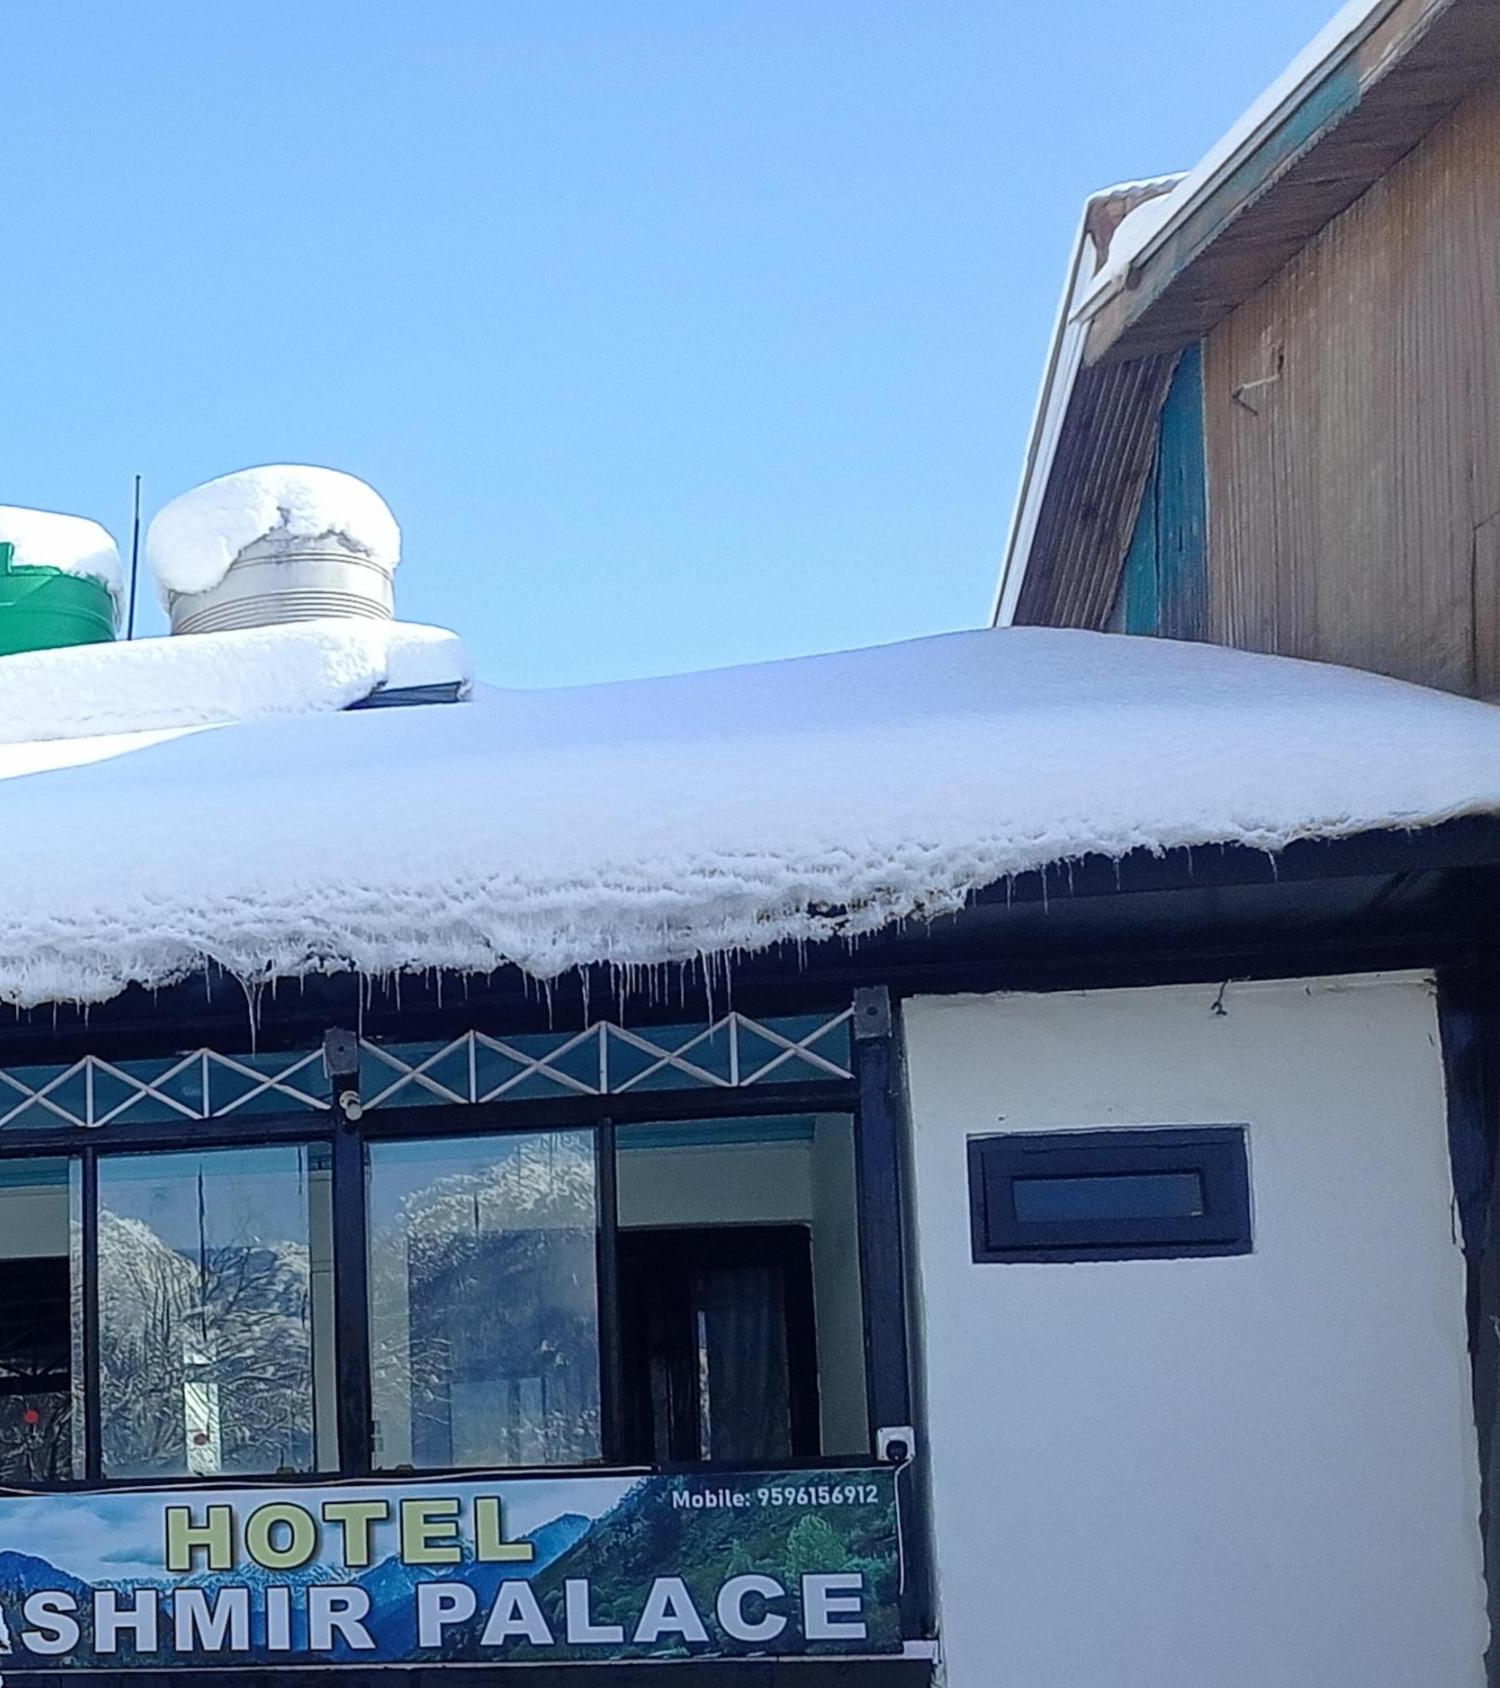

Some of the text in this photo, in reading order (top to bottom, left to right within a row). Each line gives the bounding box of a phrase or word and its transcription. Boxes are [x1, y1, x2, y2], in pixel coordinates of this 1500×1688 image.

[166, 1496, 533, 1570] HOTEL
[672, 1485, 878, 1508] Mobile: 9596156912
[416, 1573, 867, 1648] PALACE
